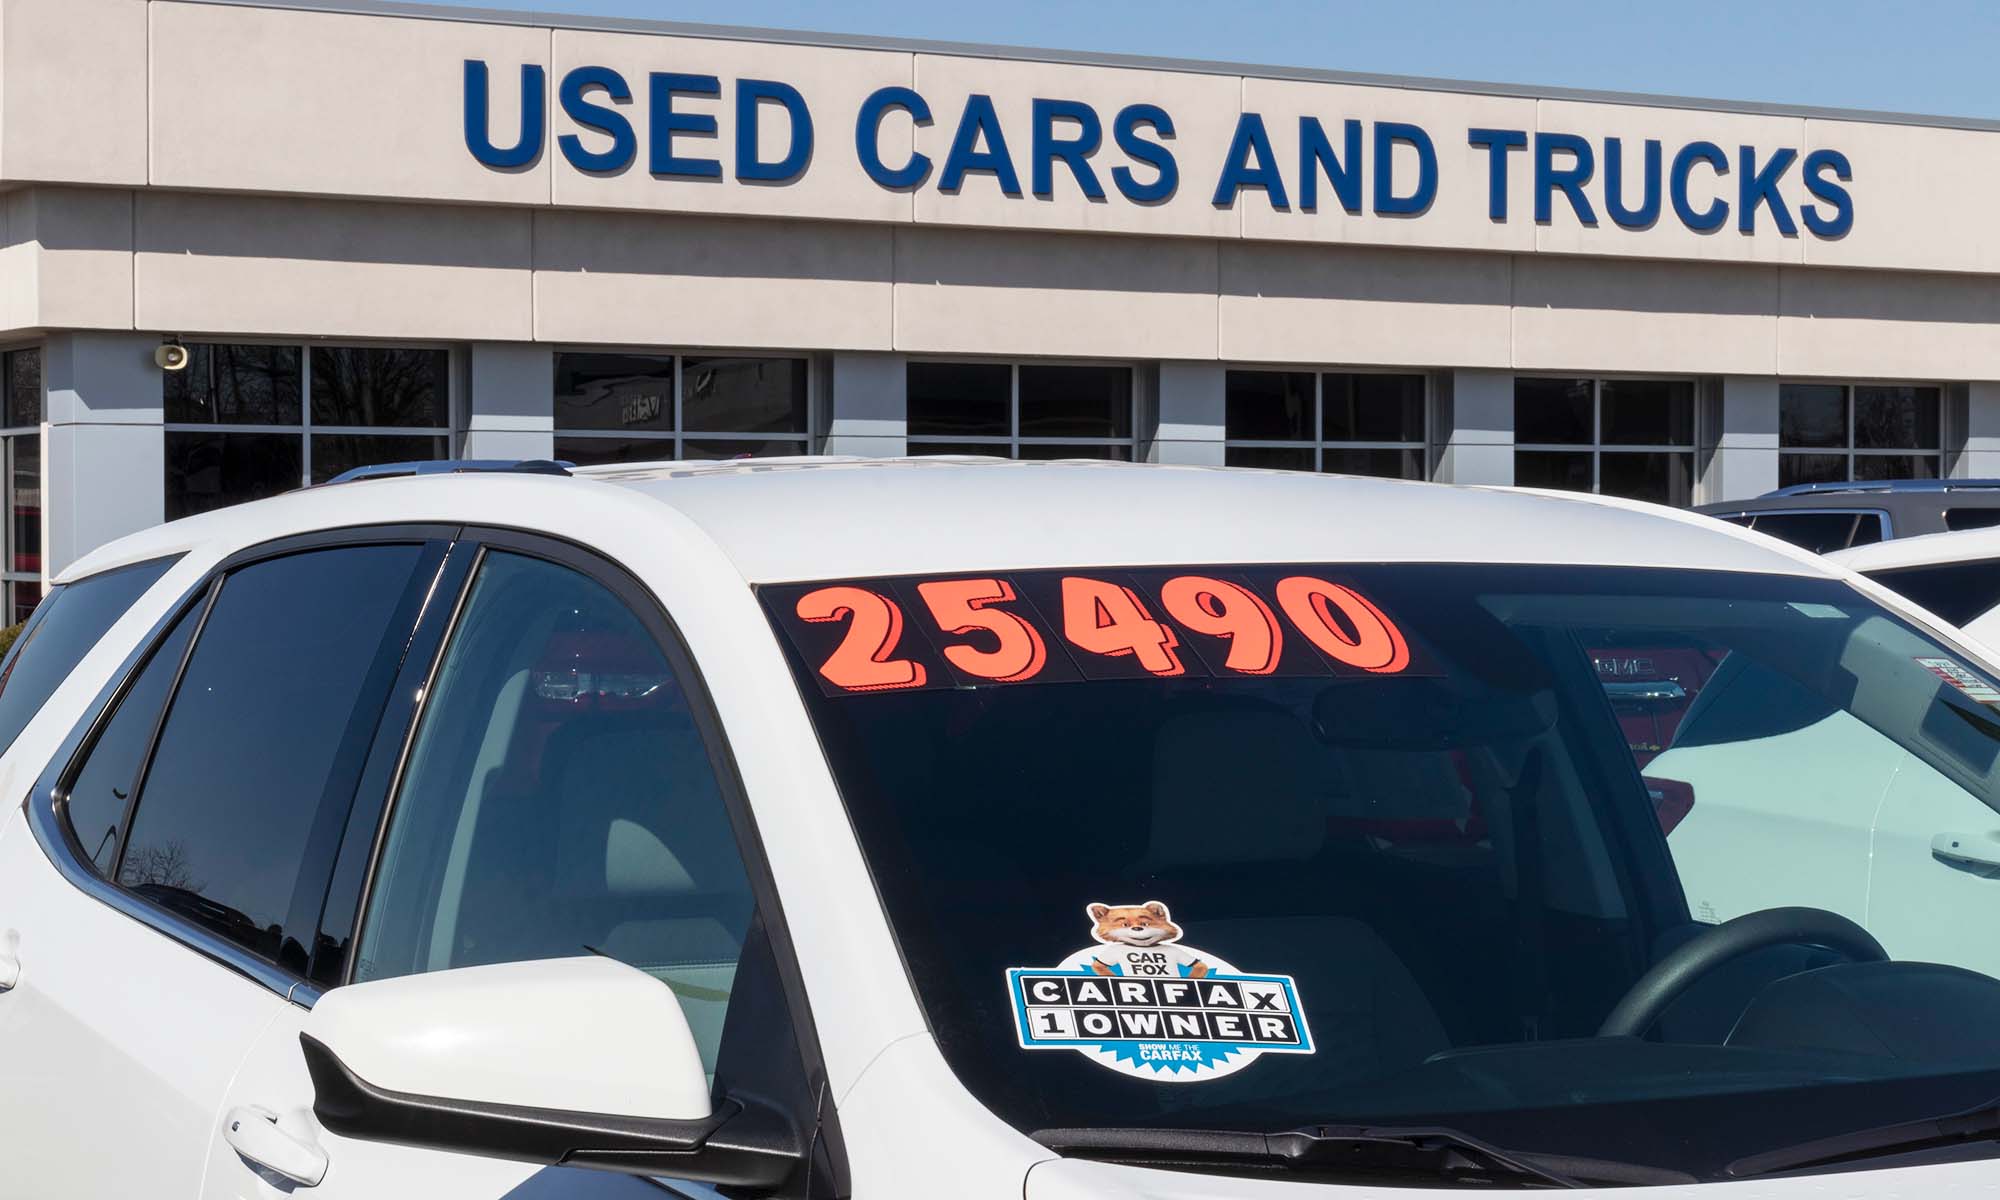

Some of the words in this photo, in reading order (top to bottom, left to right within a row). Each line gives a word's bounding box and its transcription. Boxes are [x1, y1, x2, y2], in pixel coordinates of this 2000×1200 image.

[464, 60, 814, 180] USED
[856, 86, 1178, 203] CARS
[1213, 112, 1438, 216] AND
[1468, 128, 1853, 238] TRUCKS
[796, 575, 1411, 691] 25490
[1126, 952, 1167, 964] CAR
[1131, 964, 1169, 976] FOX
[1031, 980, 1277, 1011] CARFAX
[1040, 1012, 1066, 1034] 1
[1082, 1012, 1288, 1039] OWNER
[1138, 1043, 1167, 1051] SHOW
[1183, 1044, 1200, 1052] THE
[1139, 1050, 1203, 1064] CARFAX
